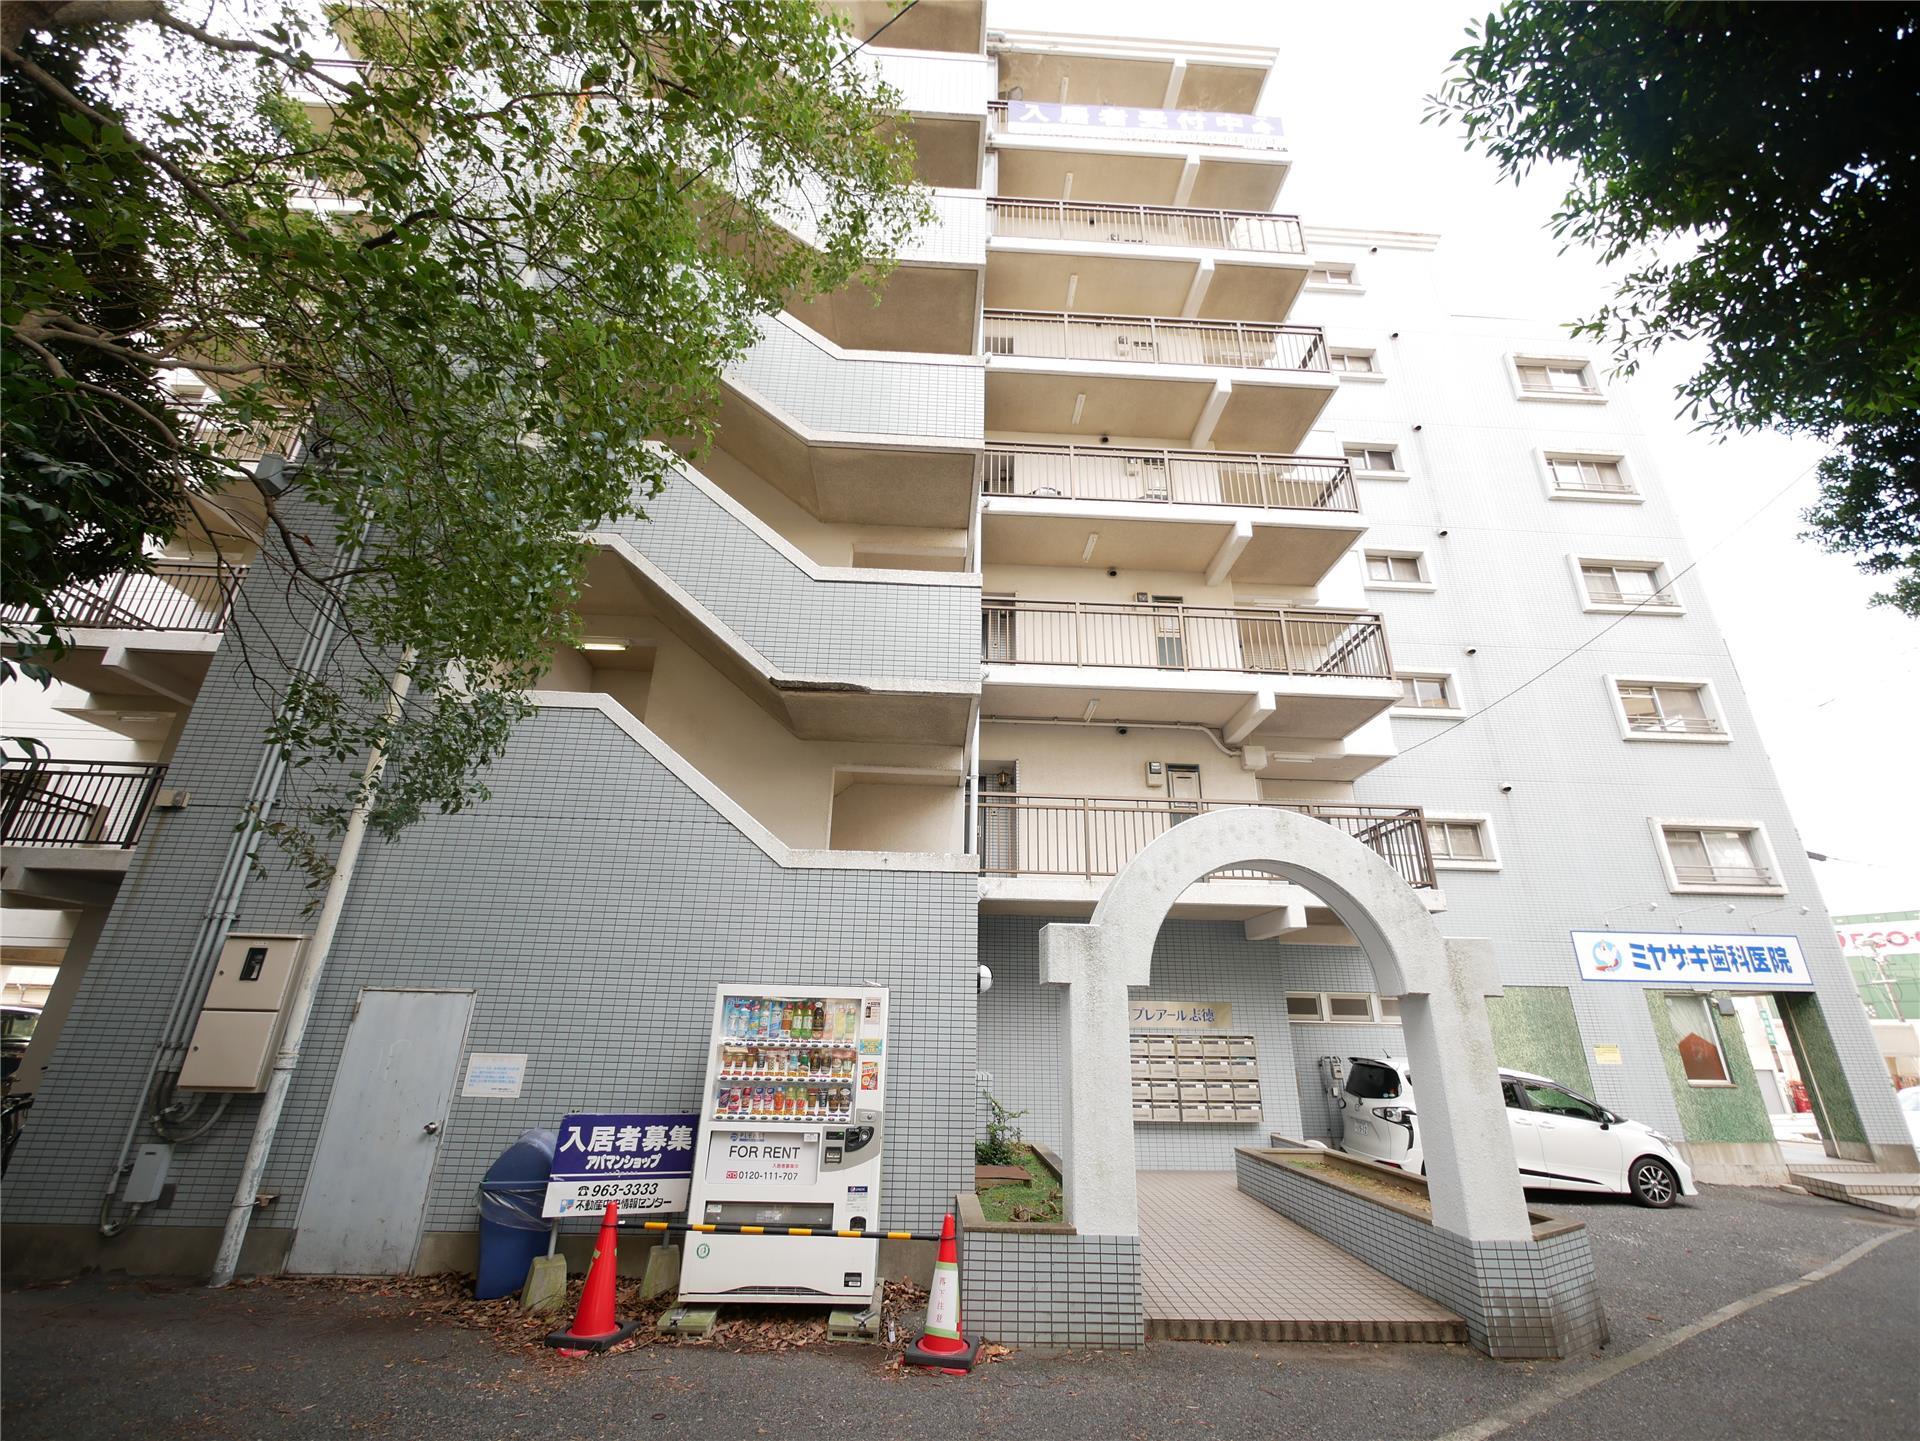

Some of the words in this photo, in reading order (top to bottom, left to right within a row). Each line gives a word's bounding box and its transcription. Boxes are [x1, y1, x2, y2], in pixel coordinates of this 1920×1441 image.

[1629, 943, 1793, 974] ミヤサキ歯科医院
[560, 1125, 693, 1153] 入居者募集
[729, 1145, 758, 1158] FOR
[763, 1146, 800, 1159] RENT
[585, 1153, 662, 1170] アパマンショップ
[738, 1171, 798, 1180] 0120-111-707
[591, 1182, 659, 1197] 963-3333
